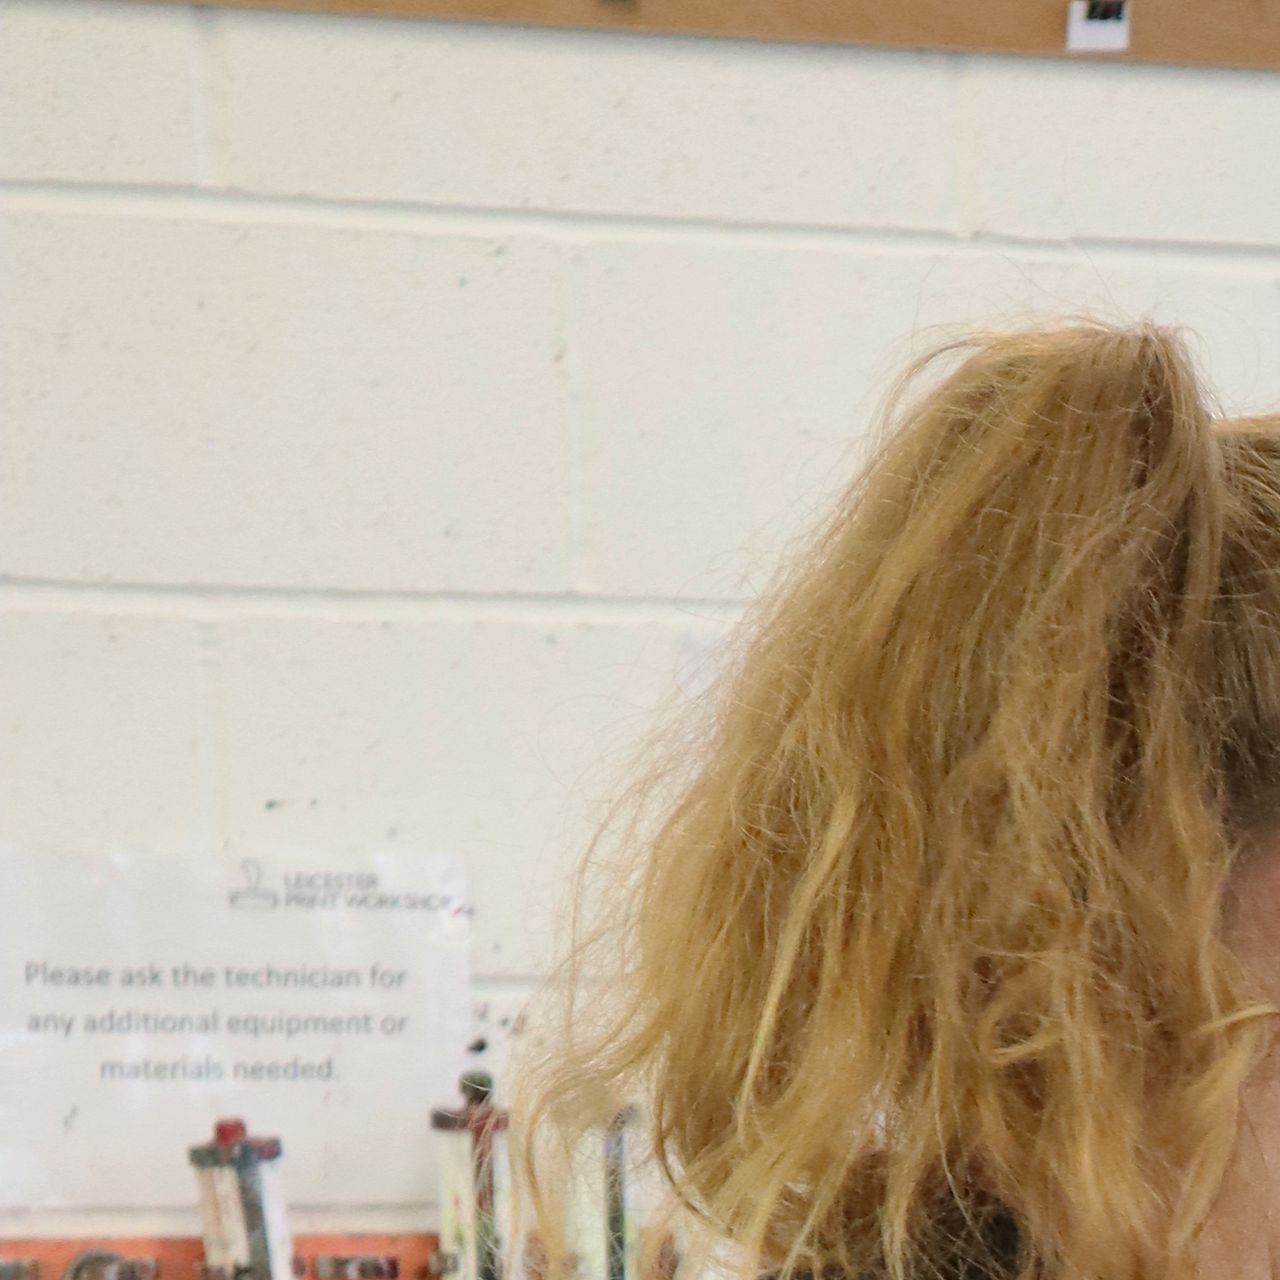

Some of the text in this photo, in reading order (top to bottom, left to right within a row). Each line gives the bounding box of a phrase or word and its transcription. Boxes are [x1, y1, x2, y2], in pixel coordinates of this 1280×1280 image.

[25, 960, 407, 988] Please ask the technician for
[26, 1008, 407, 1039] any additional equipment or
[100, 1054, 340, 1081] materials needed.
